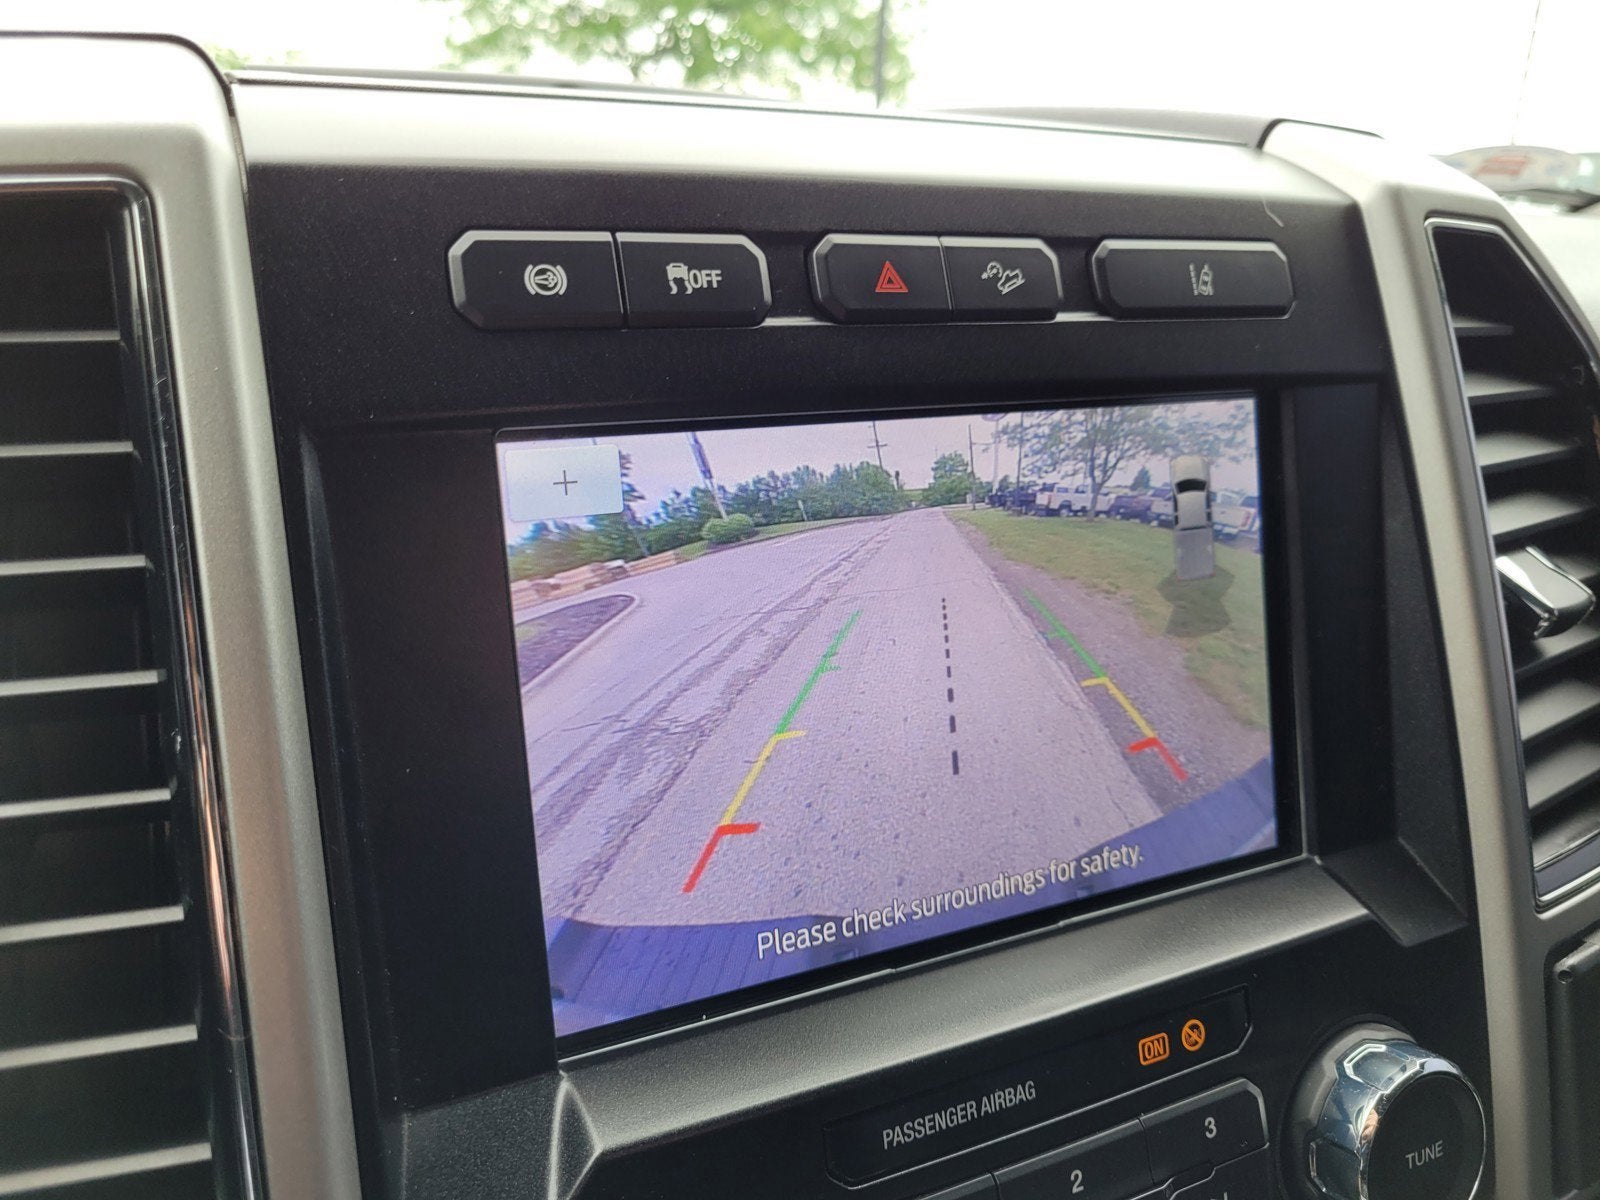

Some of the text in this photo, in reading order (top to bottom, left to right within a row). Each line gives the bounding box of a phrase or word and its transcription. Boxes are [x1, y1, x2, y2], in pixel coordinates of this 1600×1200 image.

[689, 269, 722, 288] OFF
[757, 844, 1144, 960] Please check surroundings for safety.
[1144, 1037, 1165, 1060] ON
[882, 1080, 1036, 1150] PASSENGER AIRBAG
[1204, 1116, 1217, 1139] 3
[1405, 1140, 1443, 1169] TUNE
[1070, 1169, 1084, 1194] 2
